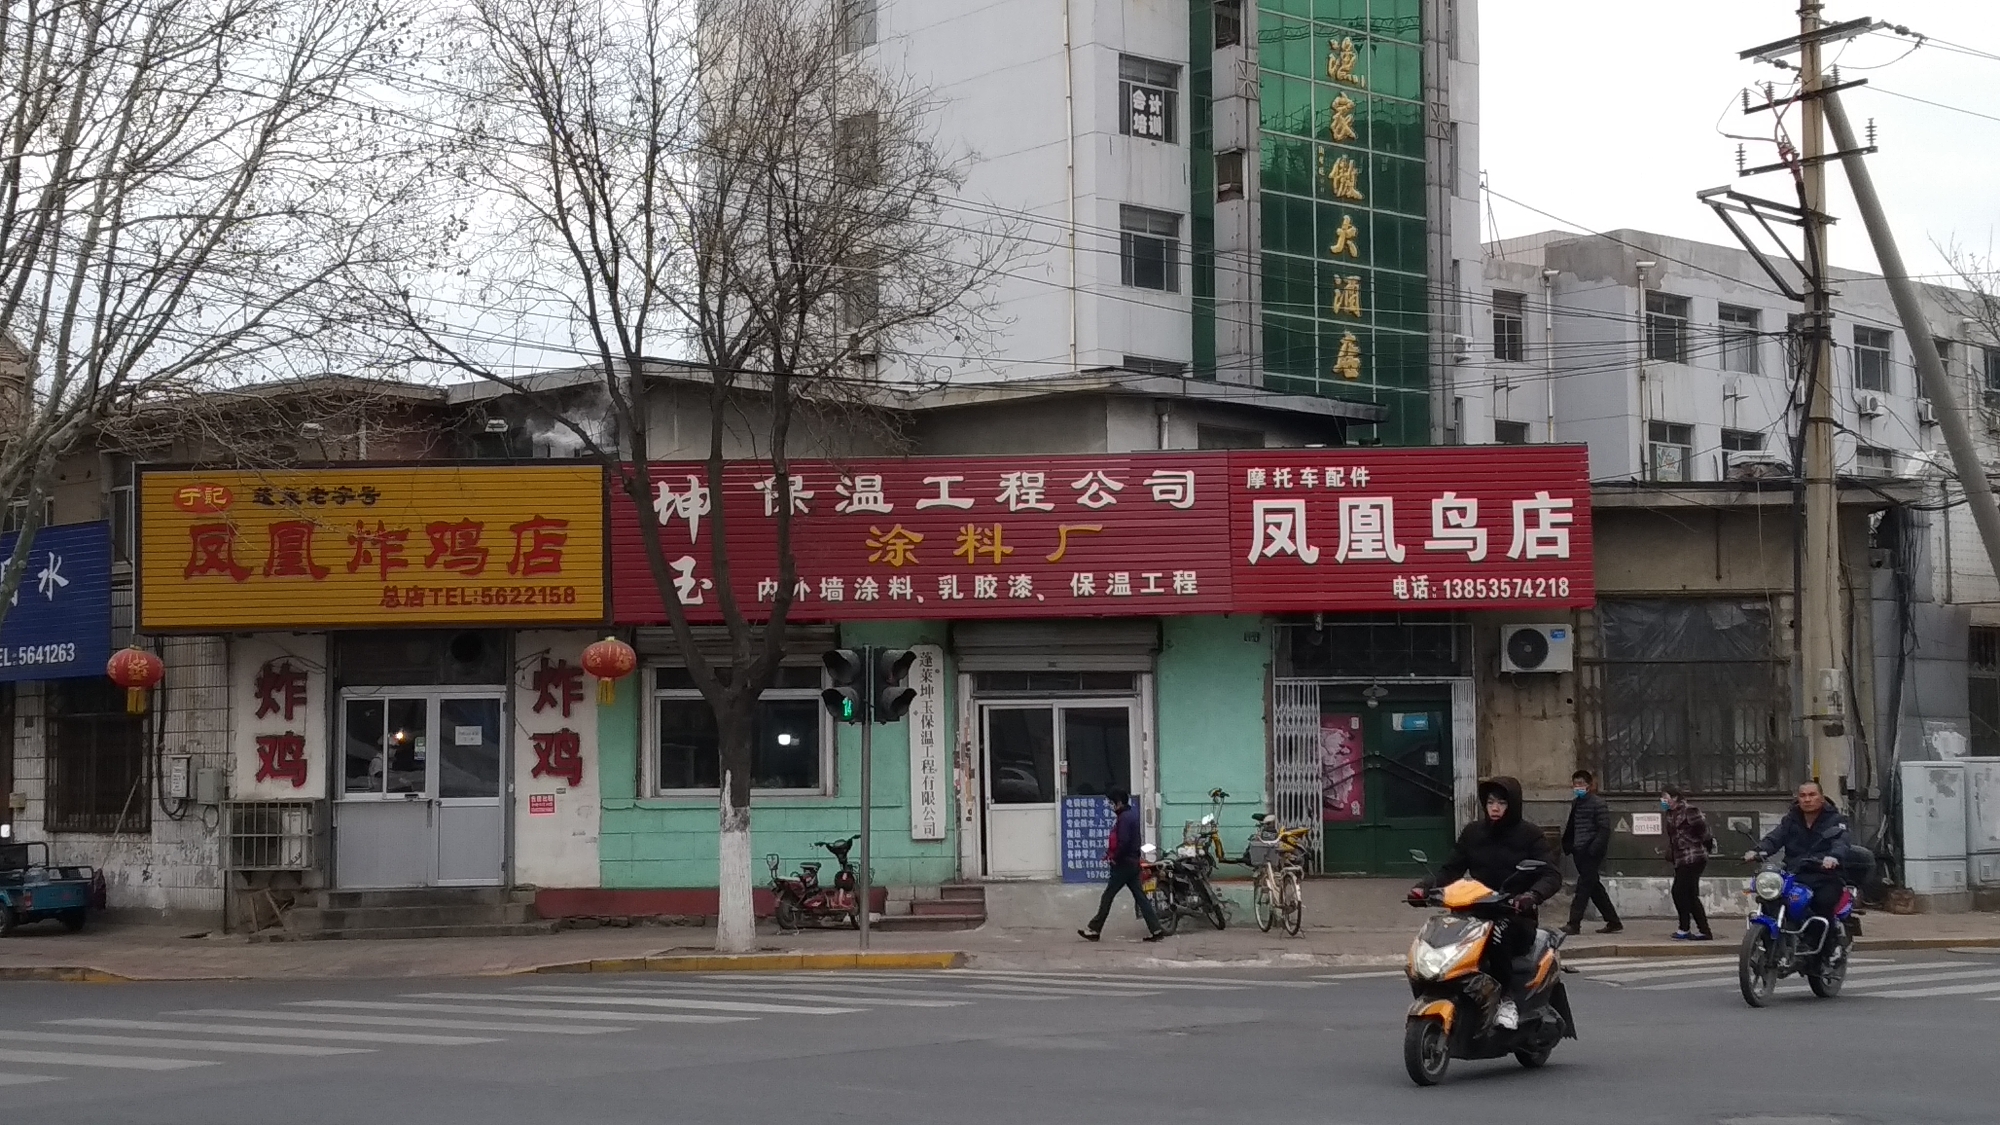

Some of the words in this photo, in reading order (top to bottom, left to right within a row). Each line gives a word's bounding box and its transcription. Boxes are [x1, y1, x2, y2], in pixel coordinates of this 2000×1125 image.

[1132, 89, 1162, 115] 会计
[1133, 112, 1162, 136] 培训
[753, 470, 1195, 517] 保温工程公司
[1246, 466, 1370, 489] 摩托车配件
[184, 514, 570, 583] 凤凰炸鸡店
[653, 474, 713, 605] 坤玉
[865, 523, 1103, 567] 涂料厂
[1247, 491, 1574, 565] 凤凰鸟店
[254, 661, 307, 788] 炸鸡
[531, 657, 584, 788] 炸鸡
[919, 651, 936, 837] 蓬莱坤玉保温工程有限公司
